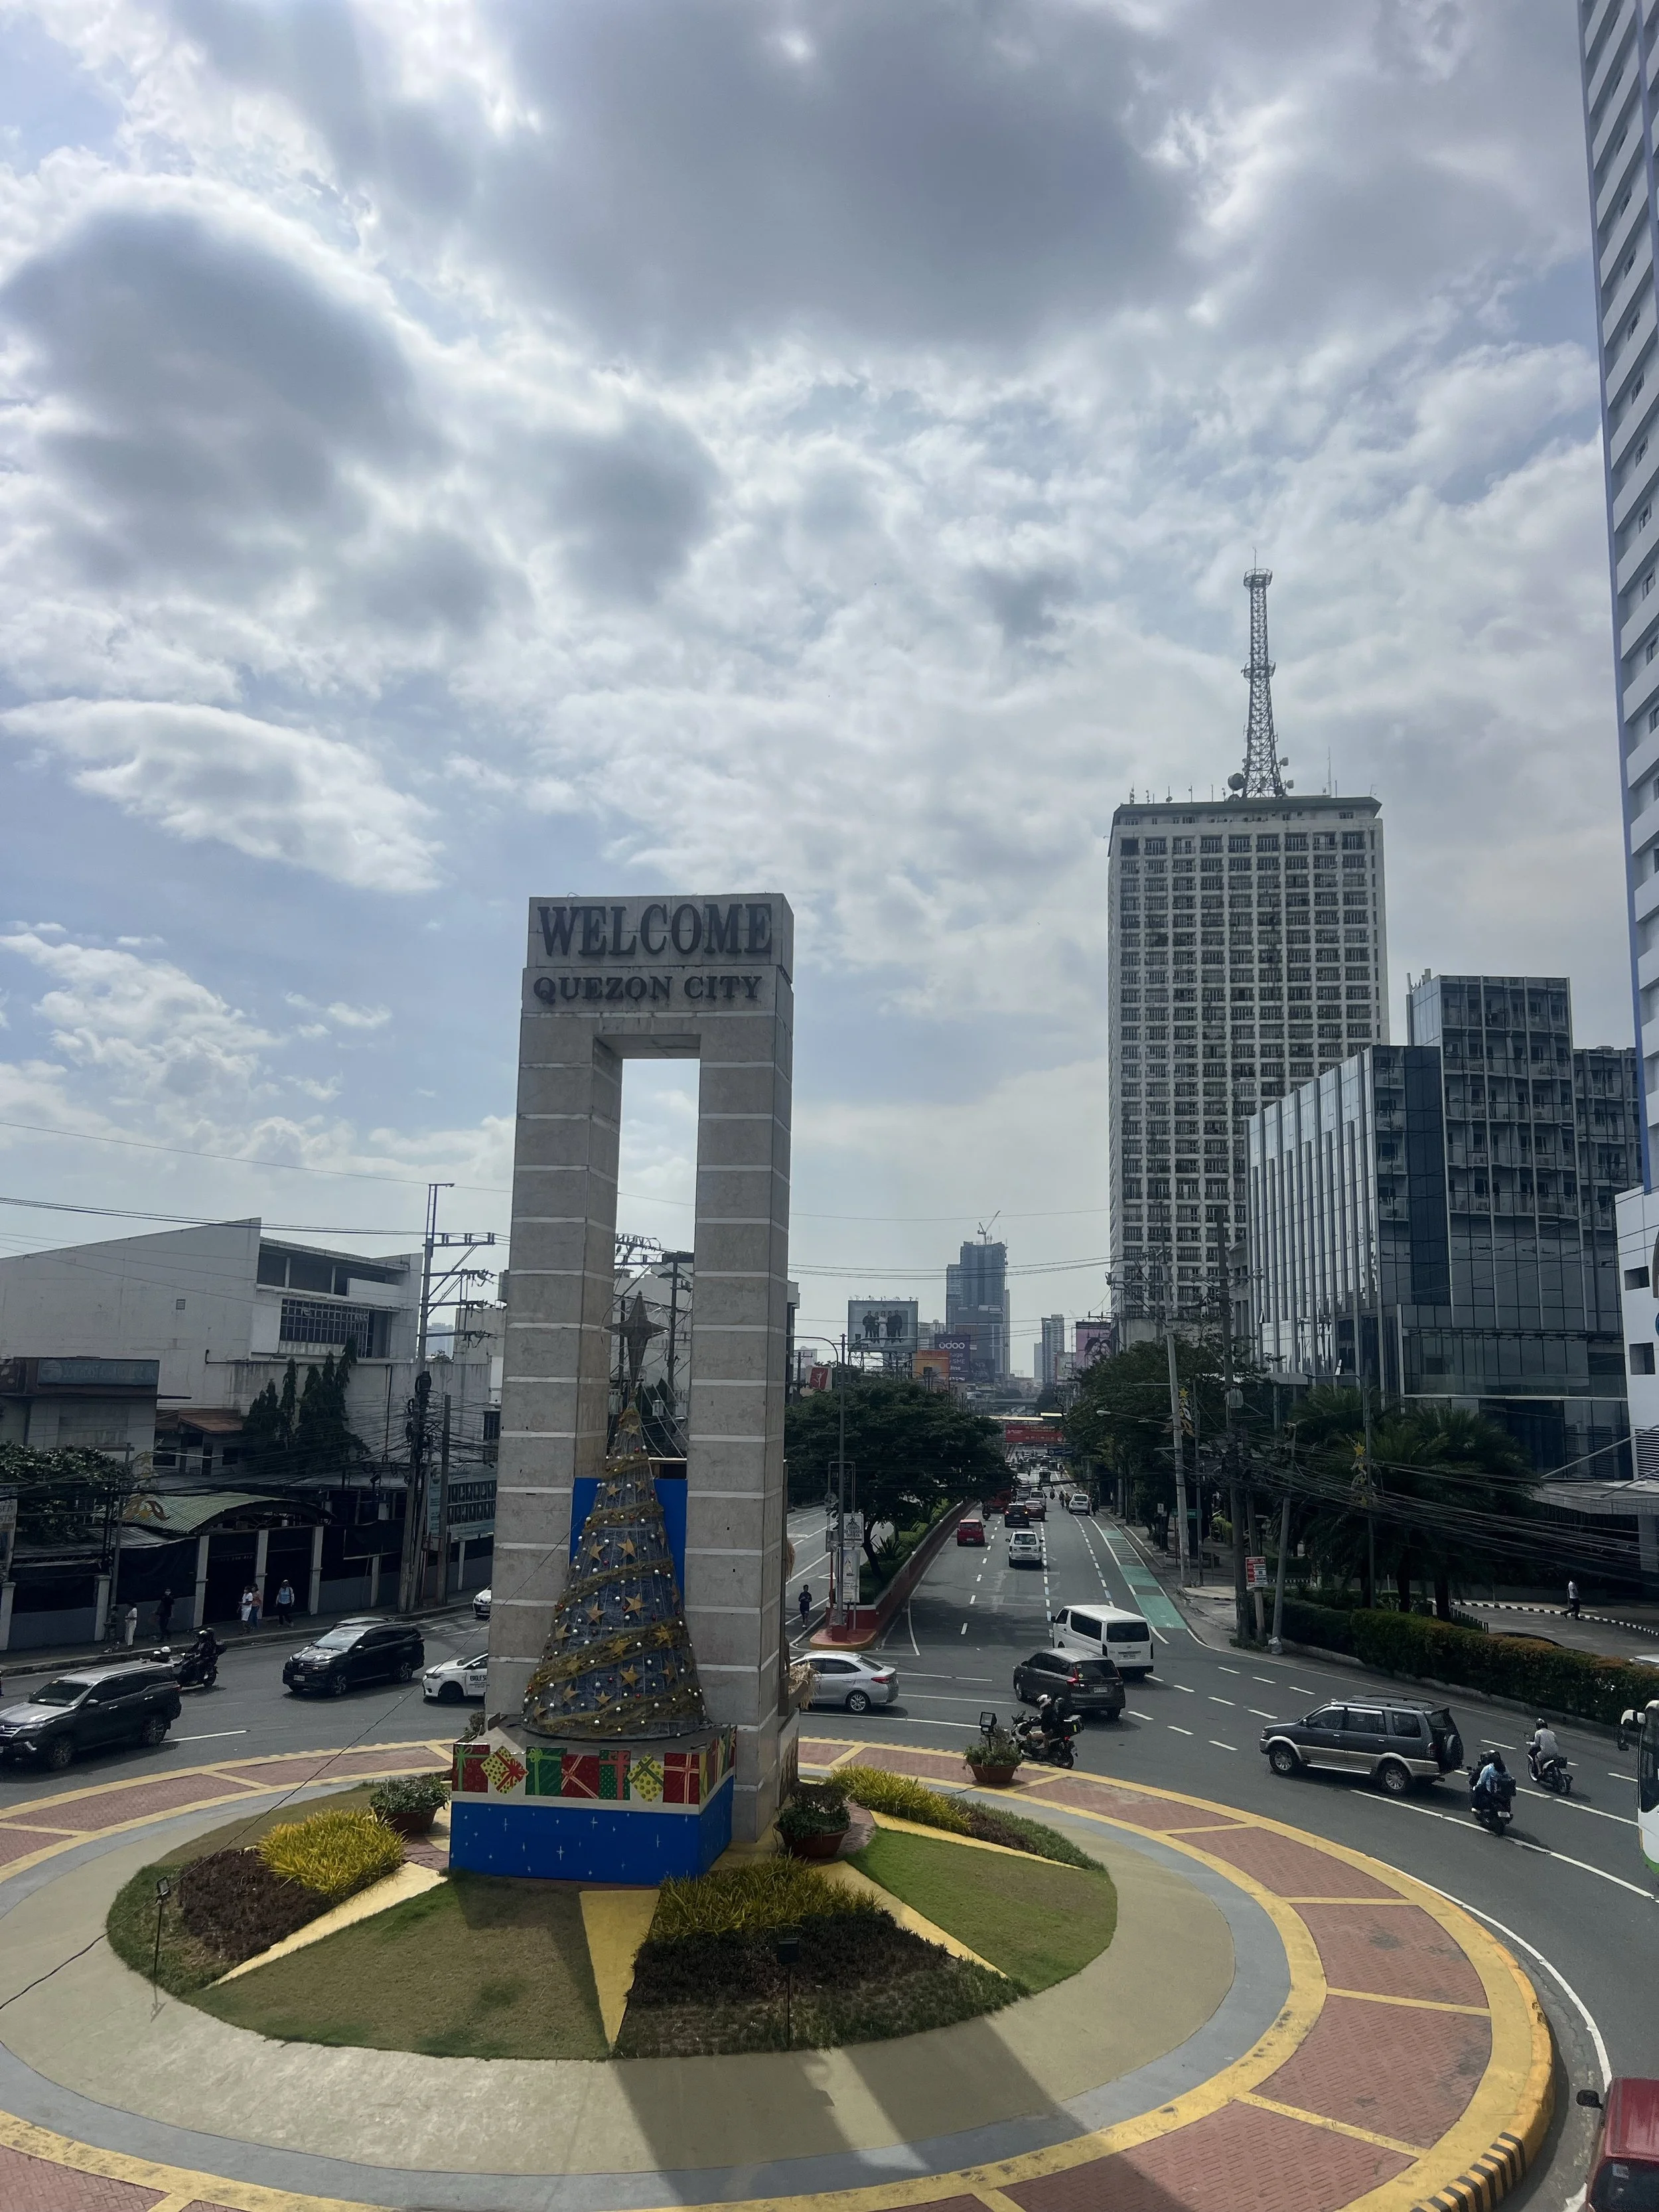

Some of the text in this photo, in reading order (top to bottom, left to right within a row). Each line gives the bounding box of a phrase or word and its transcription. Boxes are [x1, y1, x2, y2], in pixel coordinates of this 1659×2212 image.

[537, 903, 772, 956] WELCOME
[534, 976, 762, 1004] QUEZON CITY
[939, 1341, 965, 1349] odoo
